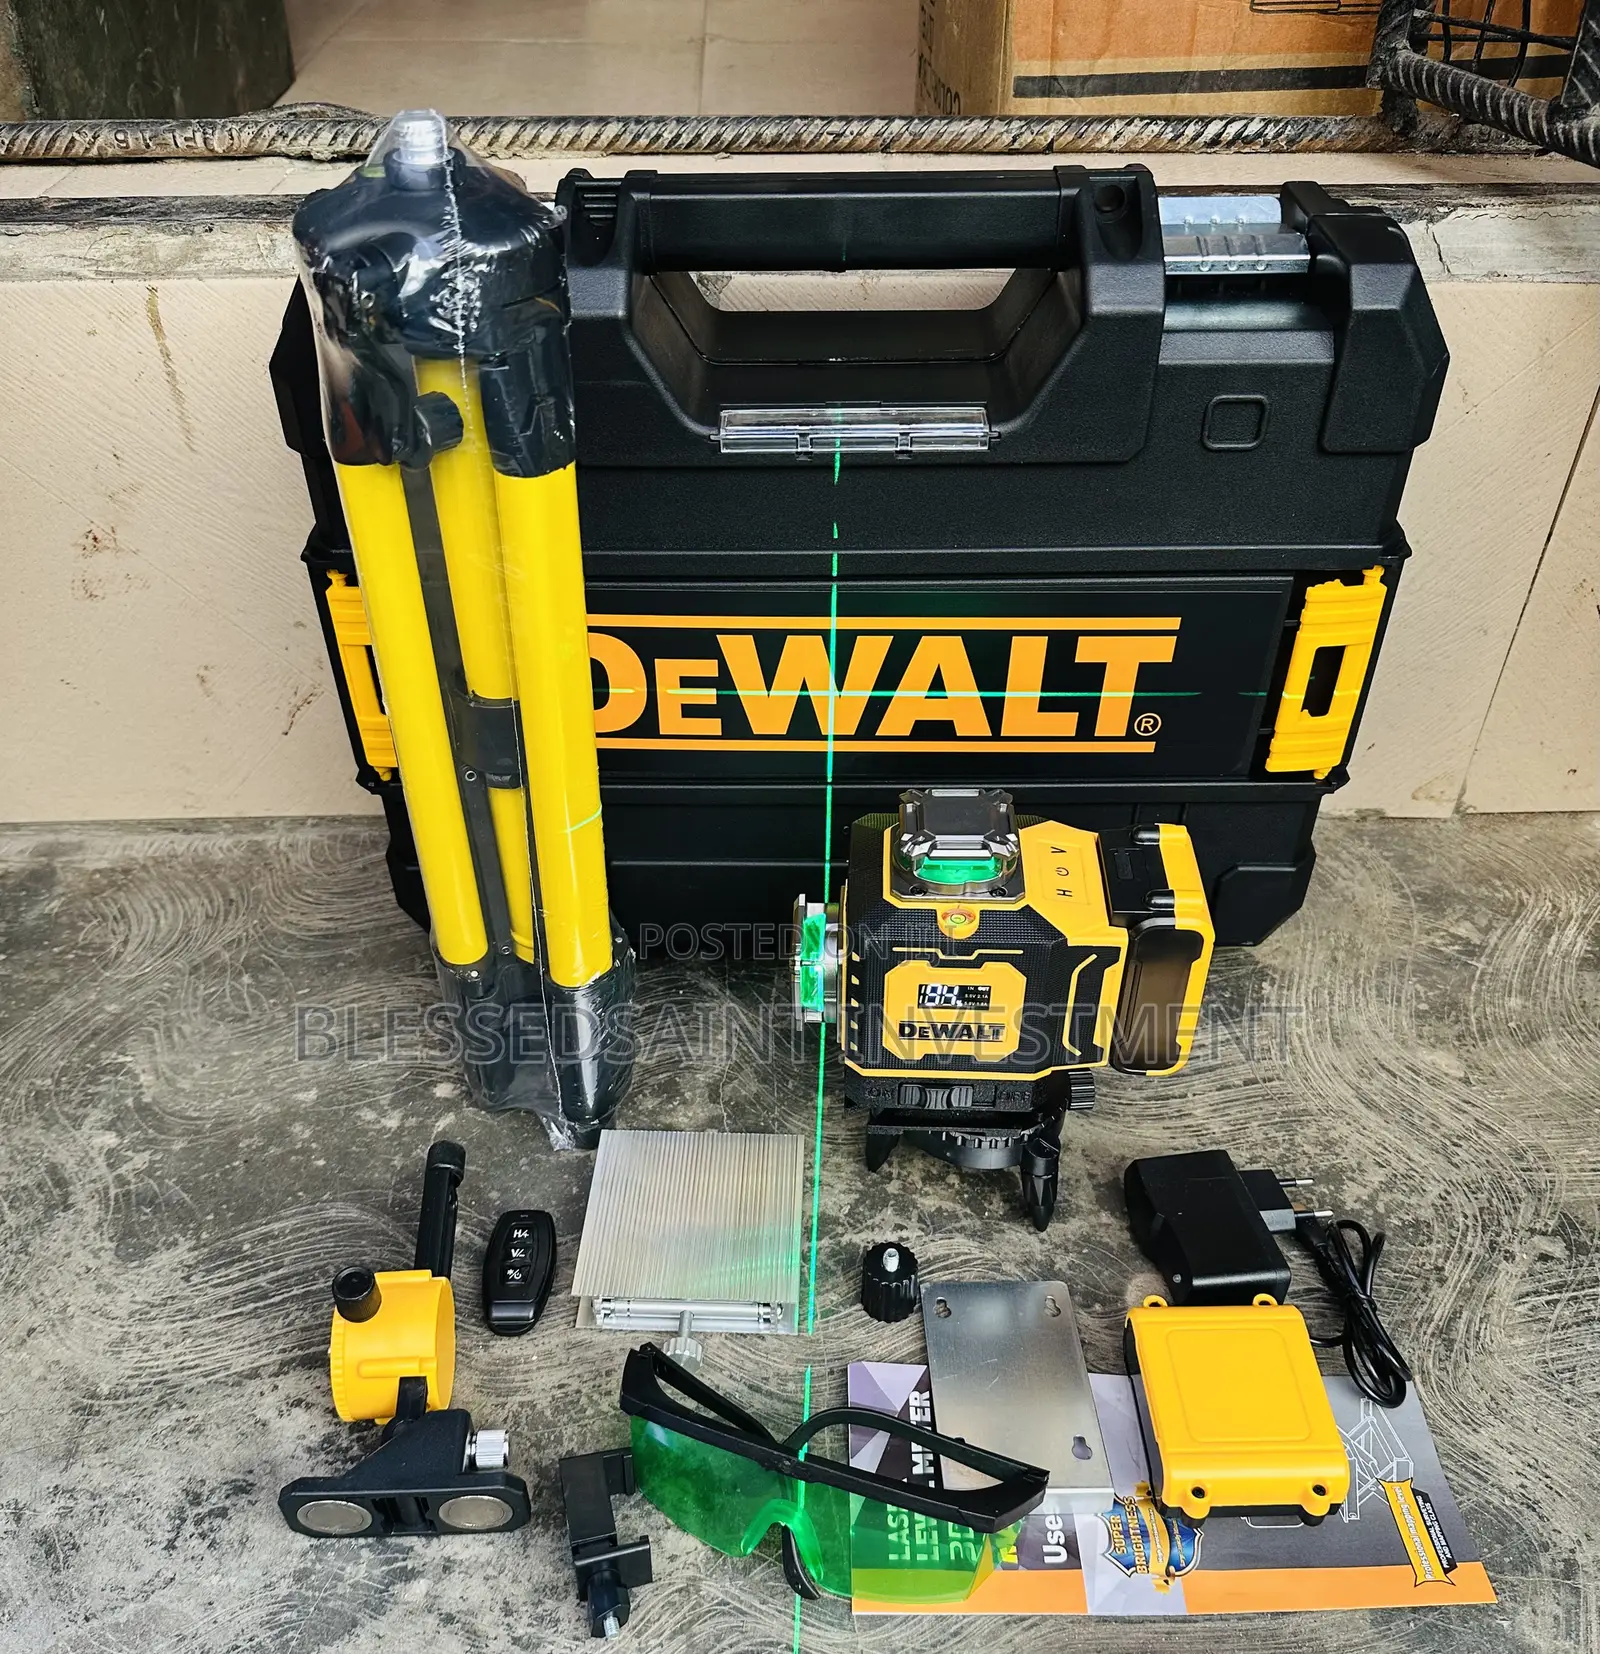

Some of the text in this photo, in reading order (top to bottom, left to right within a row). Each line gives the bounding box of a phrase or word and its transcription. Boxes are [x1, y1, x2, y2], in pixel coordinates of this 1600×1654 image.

[1110, 1514, 1127, 1555] SUPER
[1123, 1495, 1149, 1574] BRIGHTNESS
[1393, 1485, 1436, 1581] Professional mapping level
